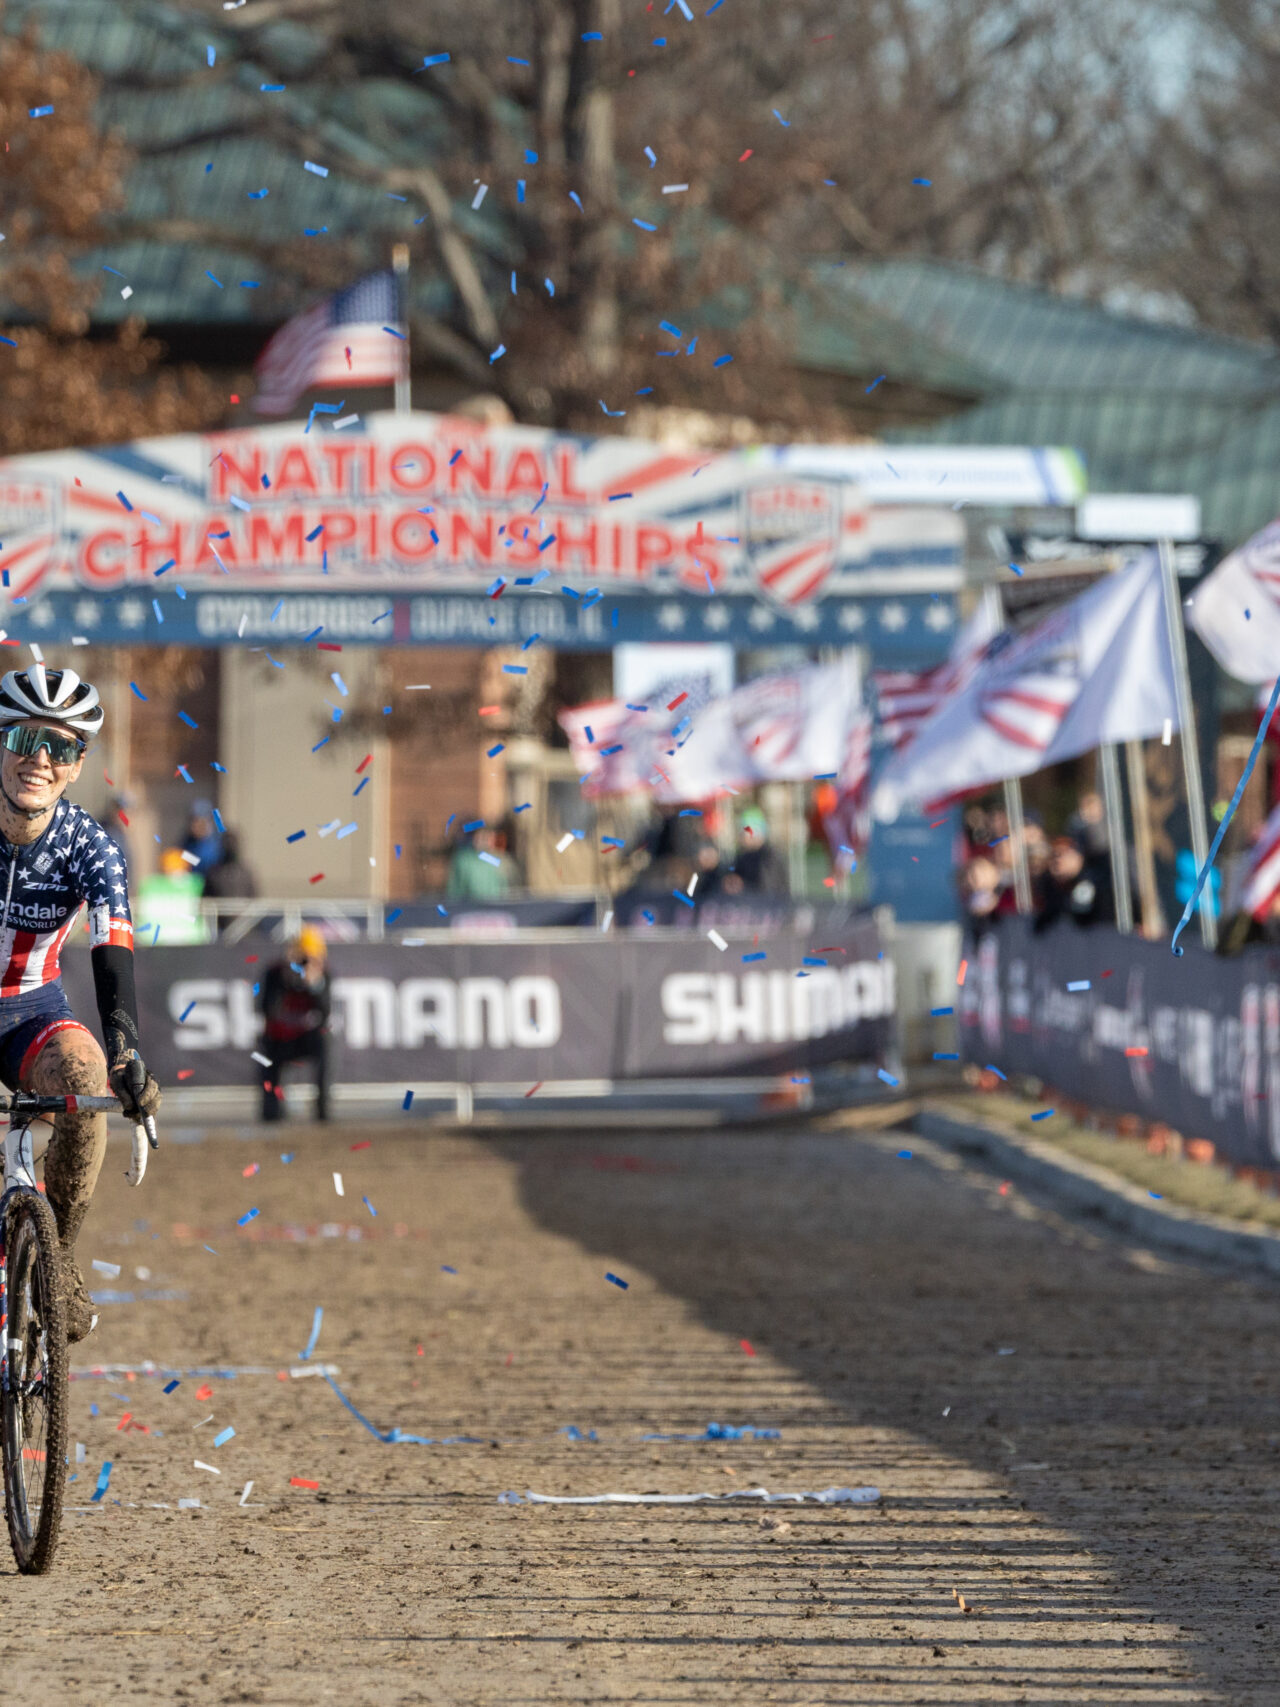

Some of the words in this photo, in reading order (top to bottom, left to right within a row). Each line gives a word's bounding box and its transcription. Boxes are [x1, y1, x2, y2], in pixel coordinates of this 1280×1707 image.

[215, 441, 588, 503] NATIONAL
[80, 511, 727, 593] CHAMPIONSHIPS
[22, 881, 69, 892] ZIPP
[167, 976, 562, 1050] SHMANO
